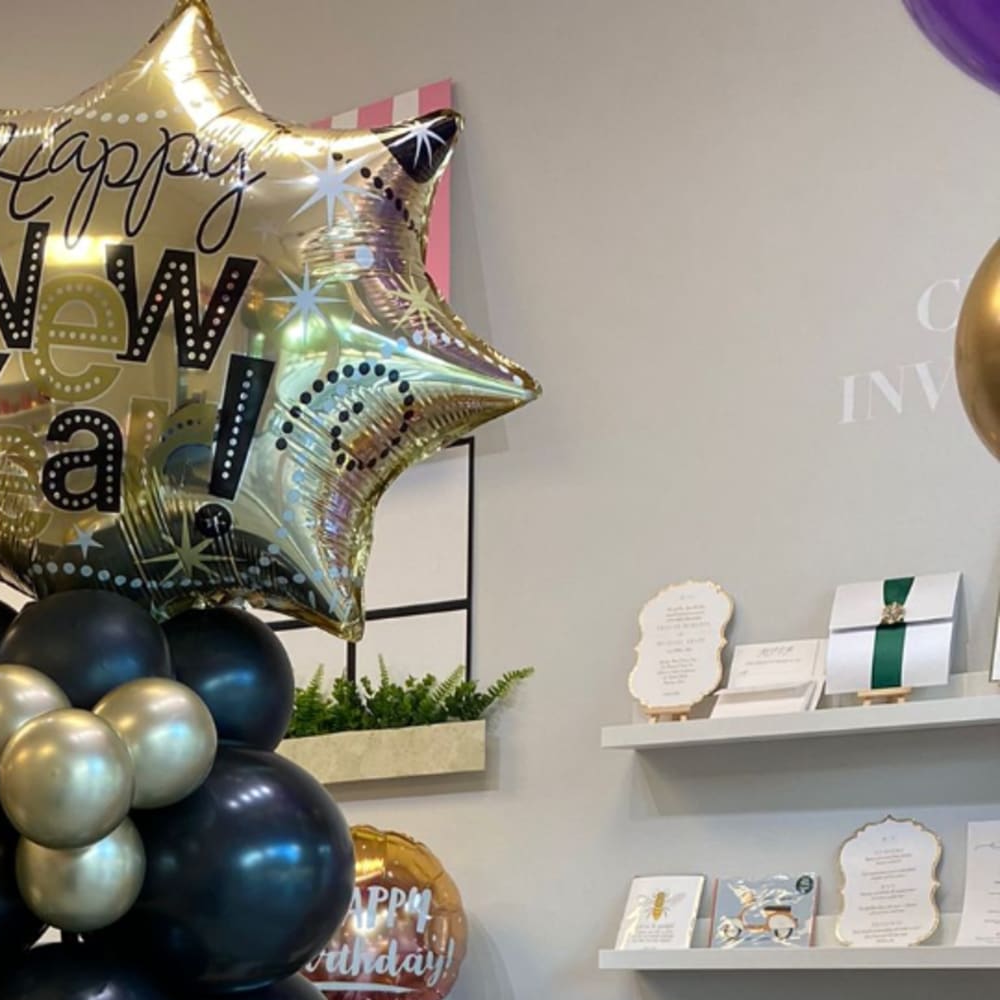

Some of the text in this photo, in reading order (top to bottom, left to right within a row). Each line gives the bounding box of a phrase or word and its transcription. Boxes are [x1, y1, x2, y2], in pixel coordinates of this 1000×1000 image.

[837, 360, 953, 424] INV
[342, 885, 433, 933] APPY
[305, 937, 456, 988] rthday!
